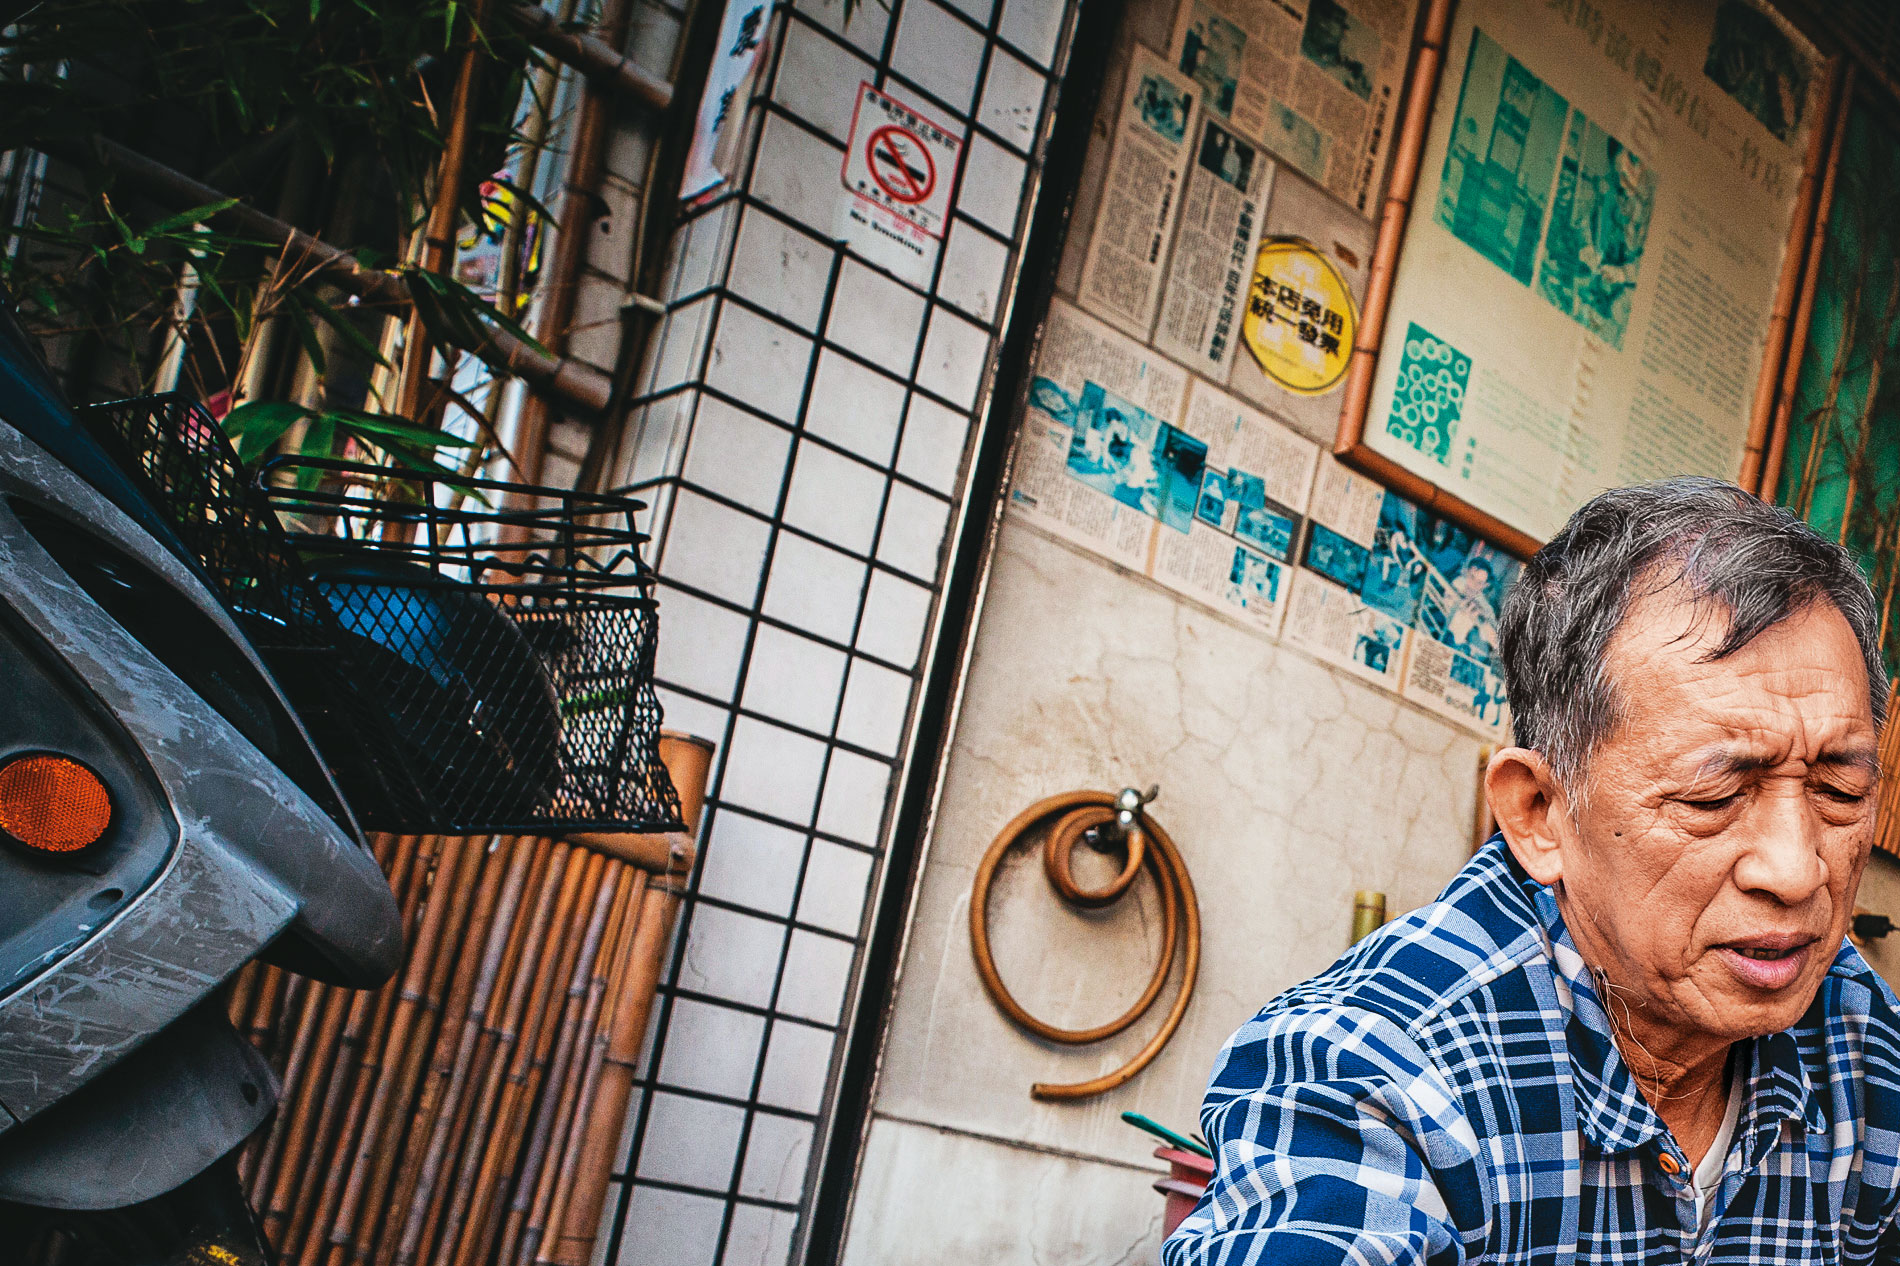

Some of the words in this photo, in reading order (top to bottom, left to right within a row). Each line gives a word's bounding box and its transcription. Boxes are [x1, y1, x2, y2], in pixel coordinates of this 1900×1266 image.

[1250, 294, 1341, 358] 統一發票
[1253, 271, 1344, 336] 本店免用
